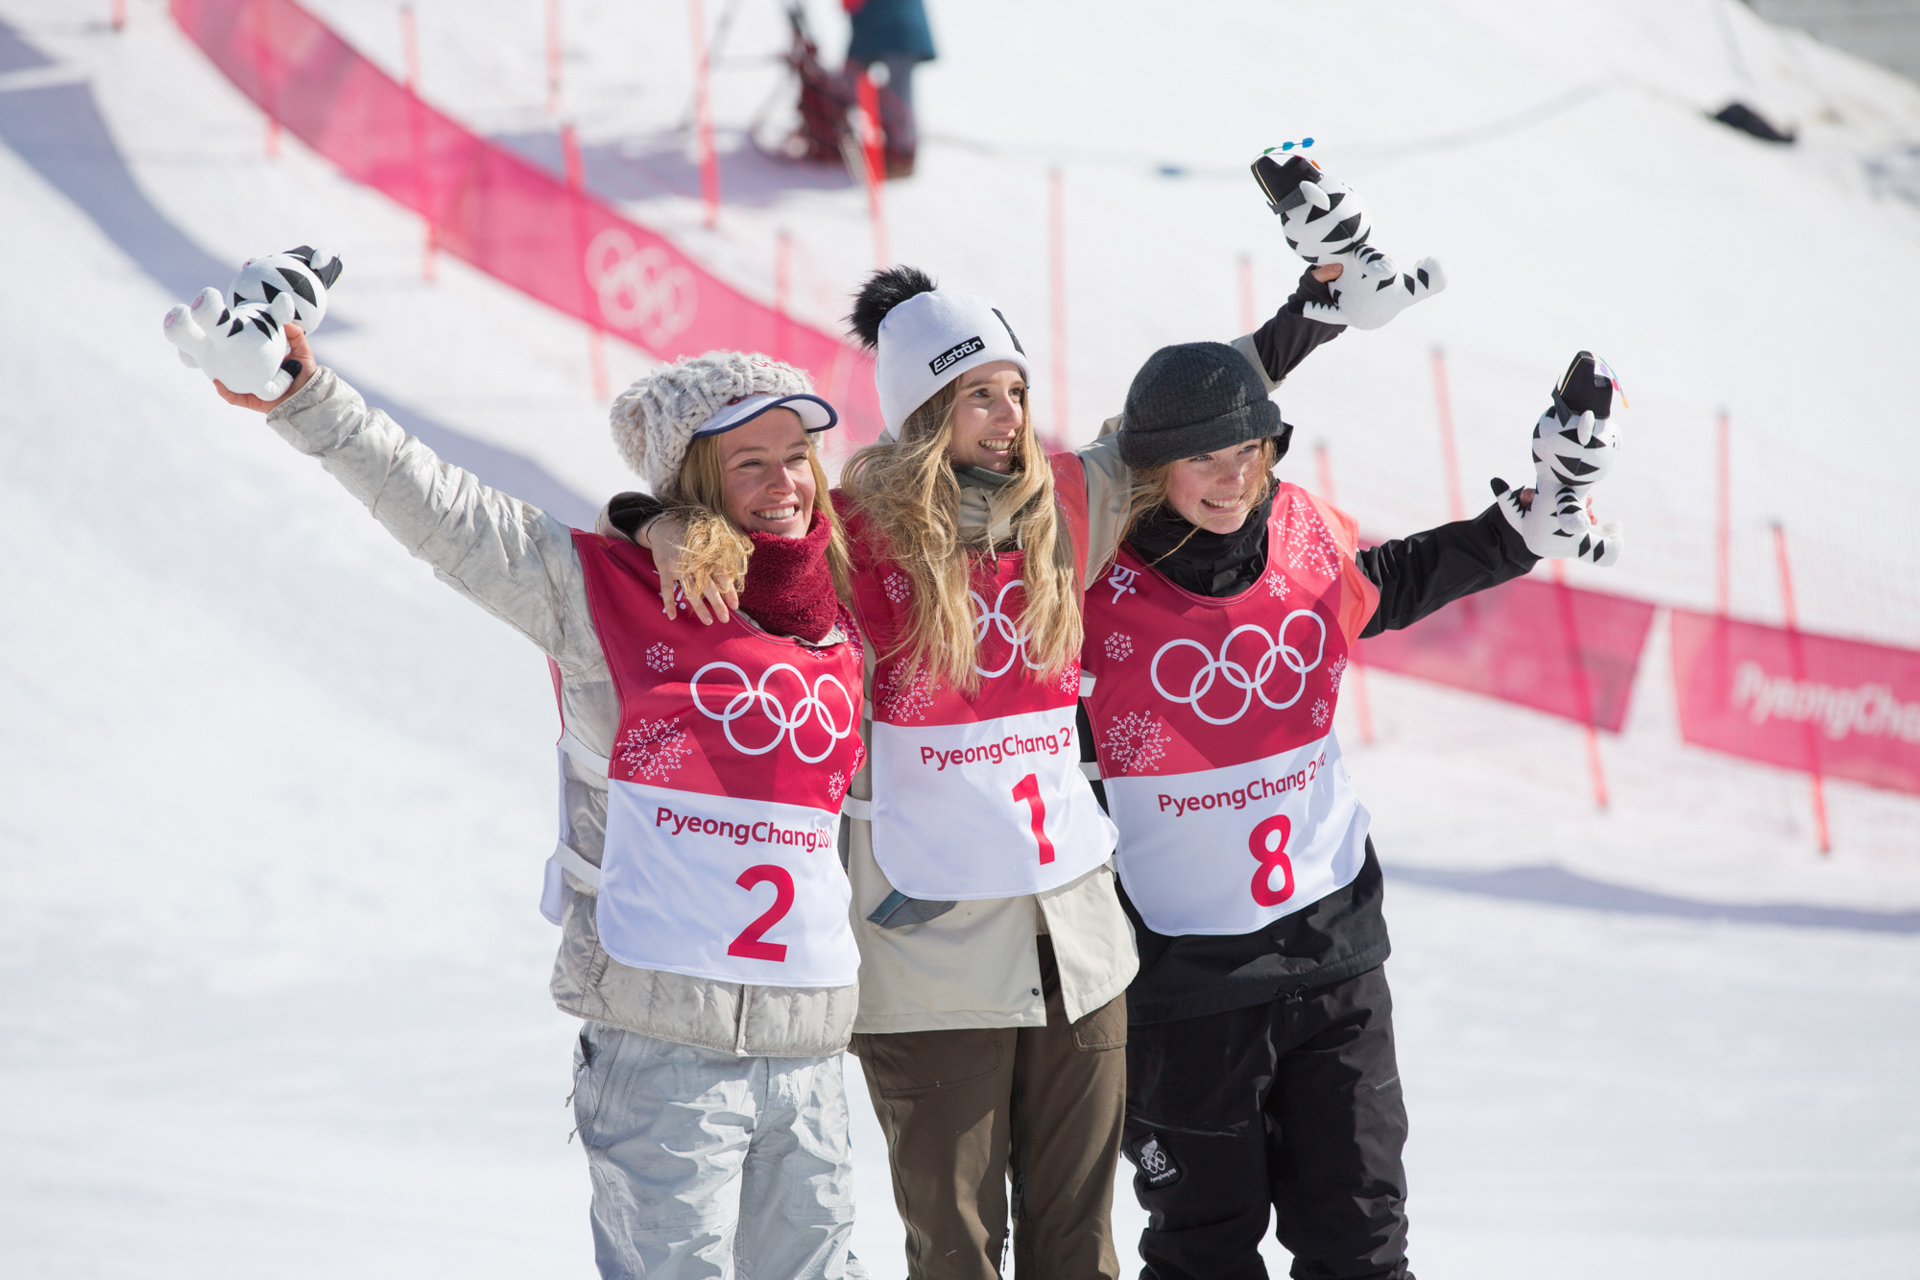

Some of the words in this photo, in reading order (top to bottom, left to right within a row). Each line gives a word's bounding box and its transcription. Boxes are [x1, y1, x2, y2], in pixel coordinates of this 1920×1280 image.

[932, 340, 982, 374] Eisbär
[920, 733, 1059, 772] PyeongChang
[1059, 725, 1075, 748] 2
[1158, 769, 1306, 818] PyeongChang
[656, 806, 817, 853] PyeongChang
[1011, 773, 1056, 866] 1
[1248, 813, 1296, 908] 8
[727, 864, 795, 963] 2
